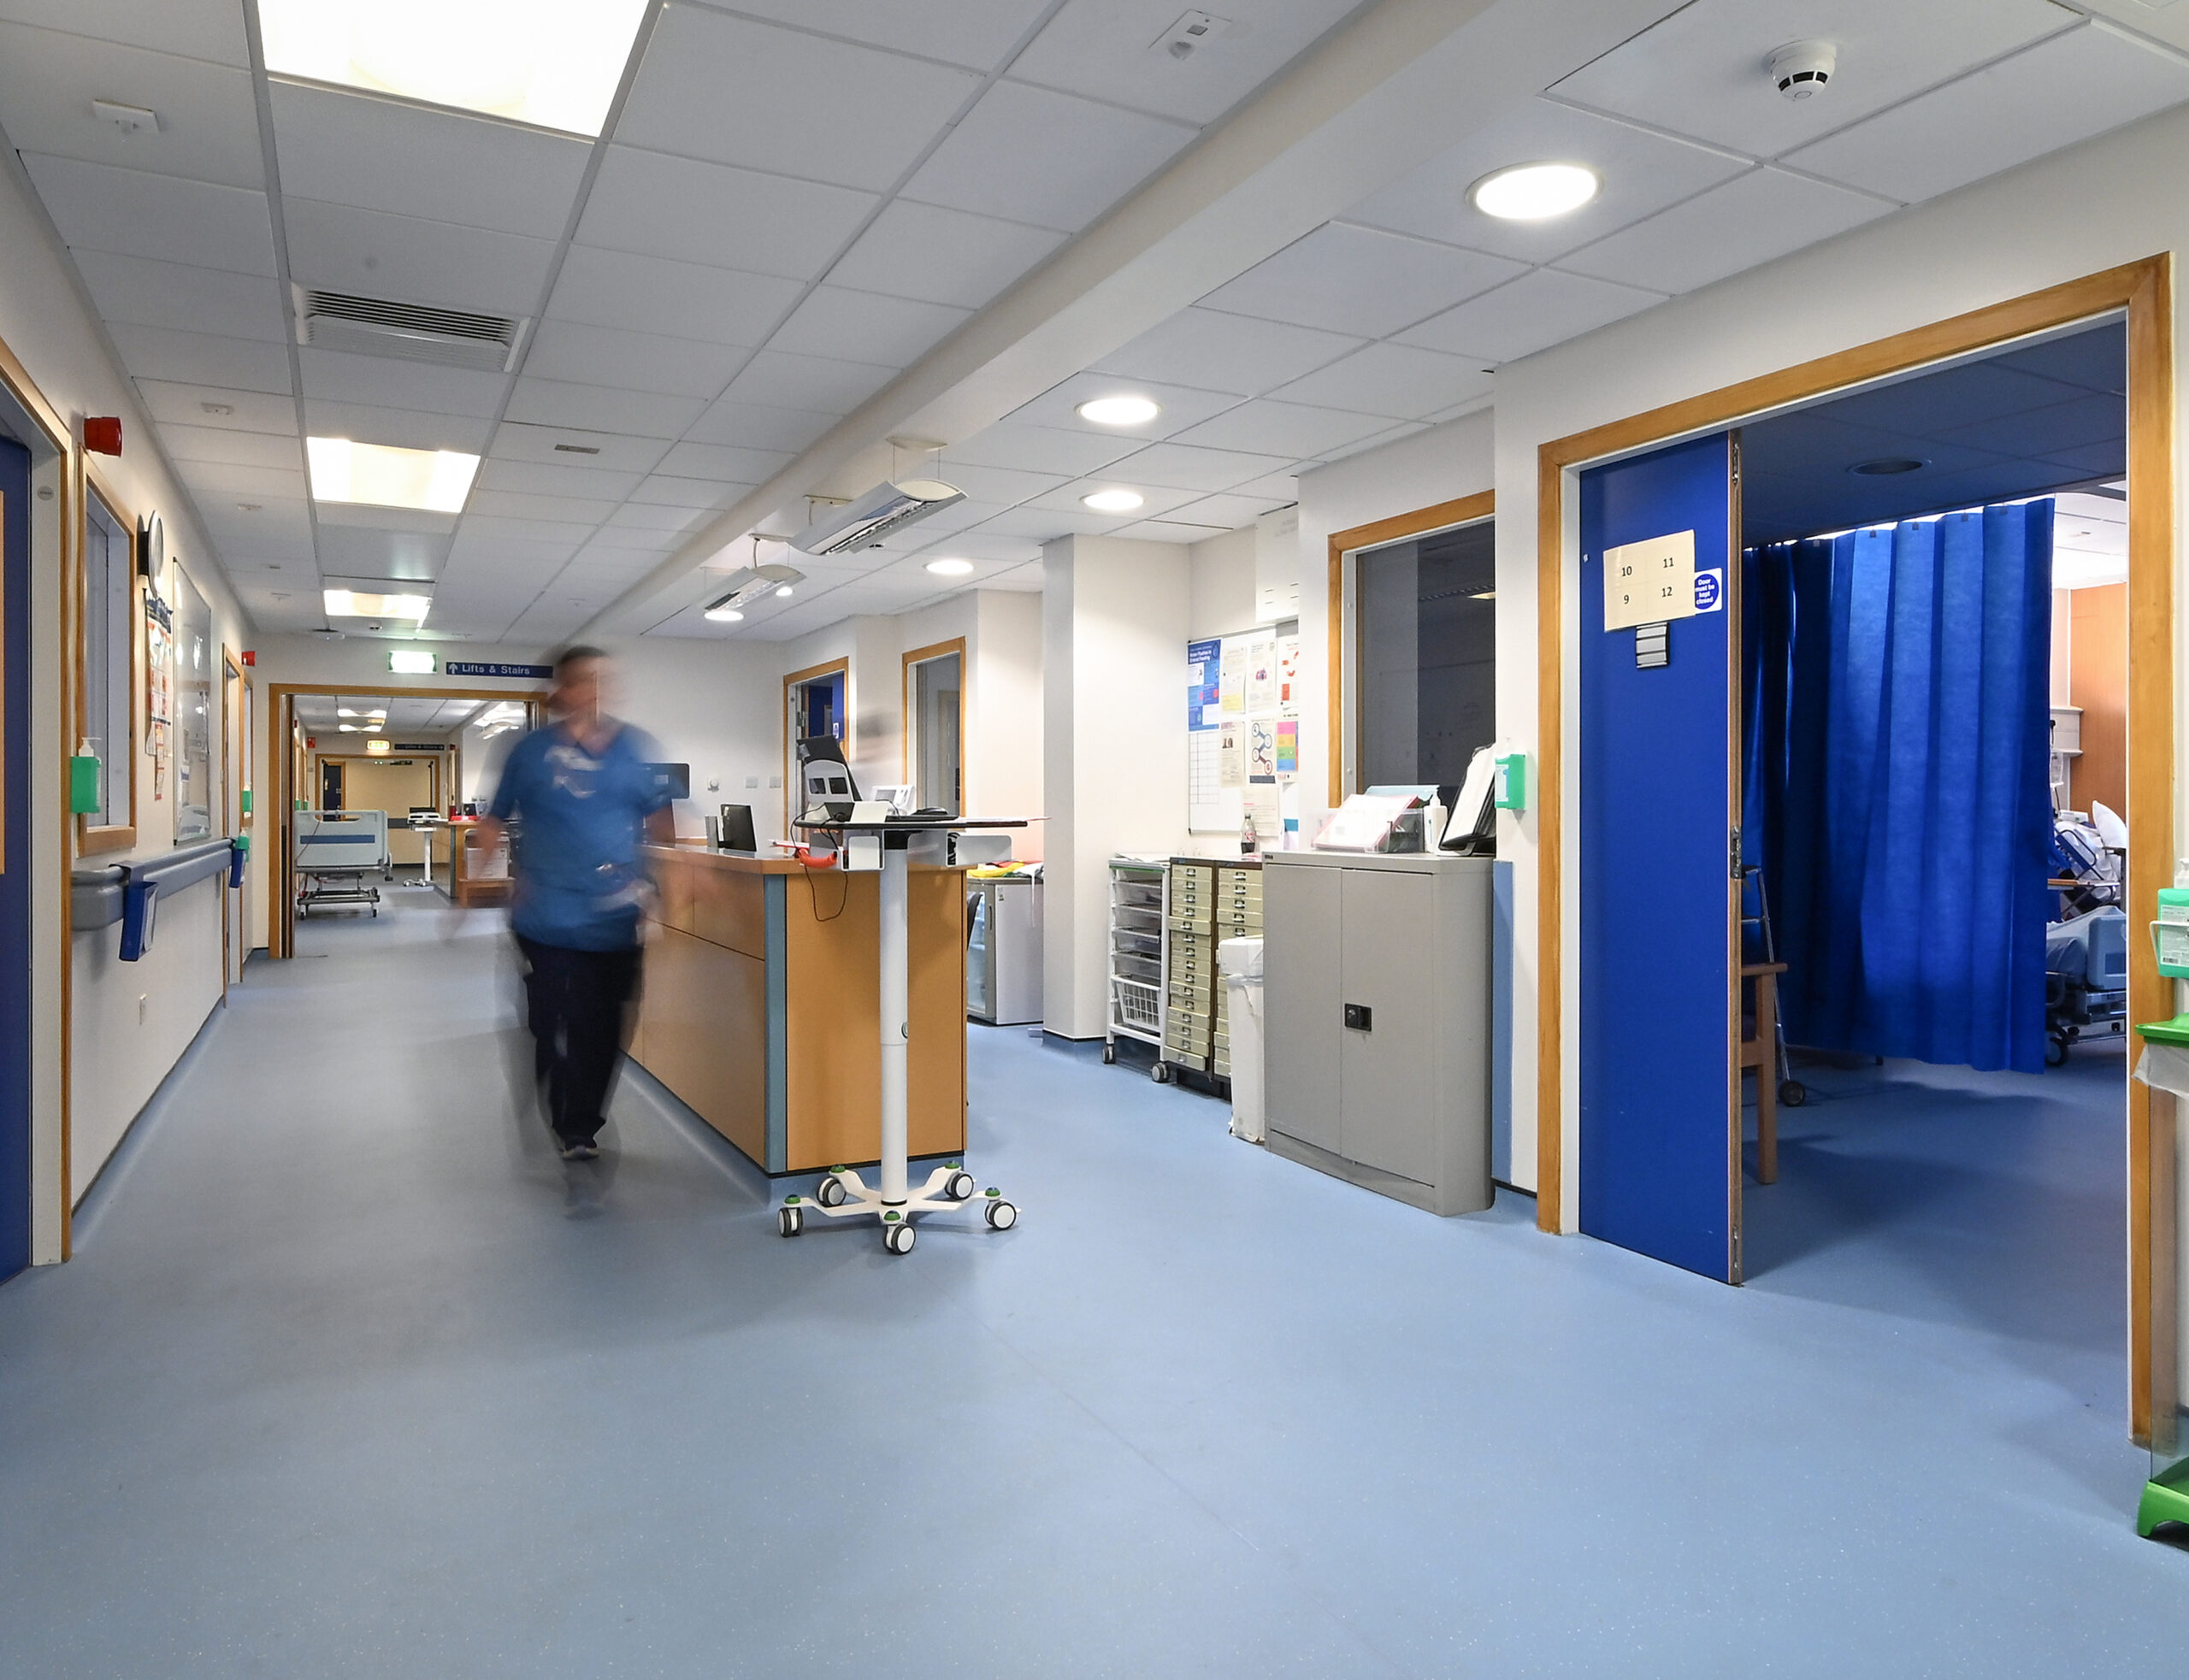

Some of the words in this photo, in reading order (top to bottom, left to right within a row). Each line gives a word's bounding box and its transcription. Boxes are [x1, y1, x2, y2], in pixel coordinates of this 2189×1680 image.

[1663, 557, 1674, 569] 11
[1621, 565, 1632, 577] 10
[1661, 586, 1673, 598] 12
[1623, 594, 1630, 604] 9
[1696, 596, 1714, 604] closed
[462, 663, 485, 673] Lifts
[488, 665, 496, 674] &
[500, 665, 530, 675] Stairs
